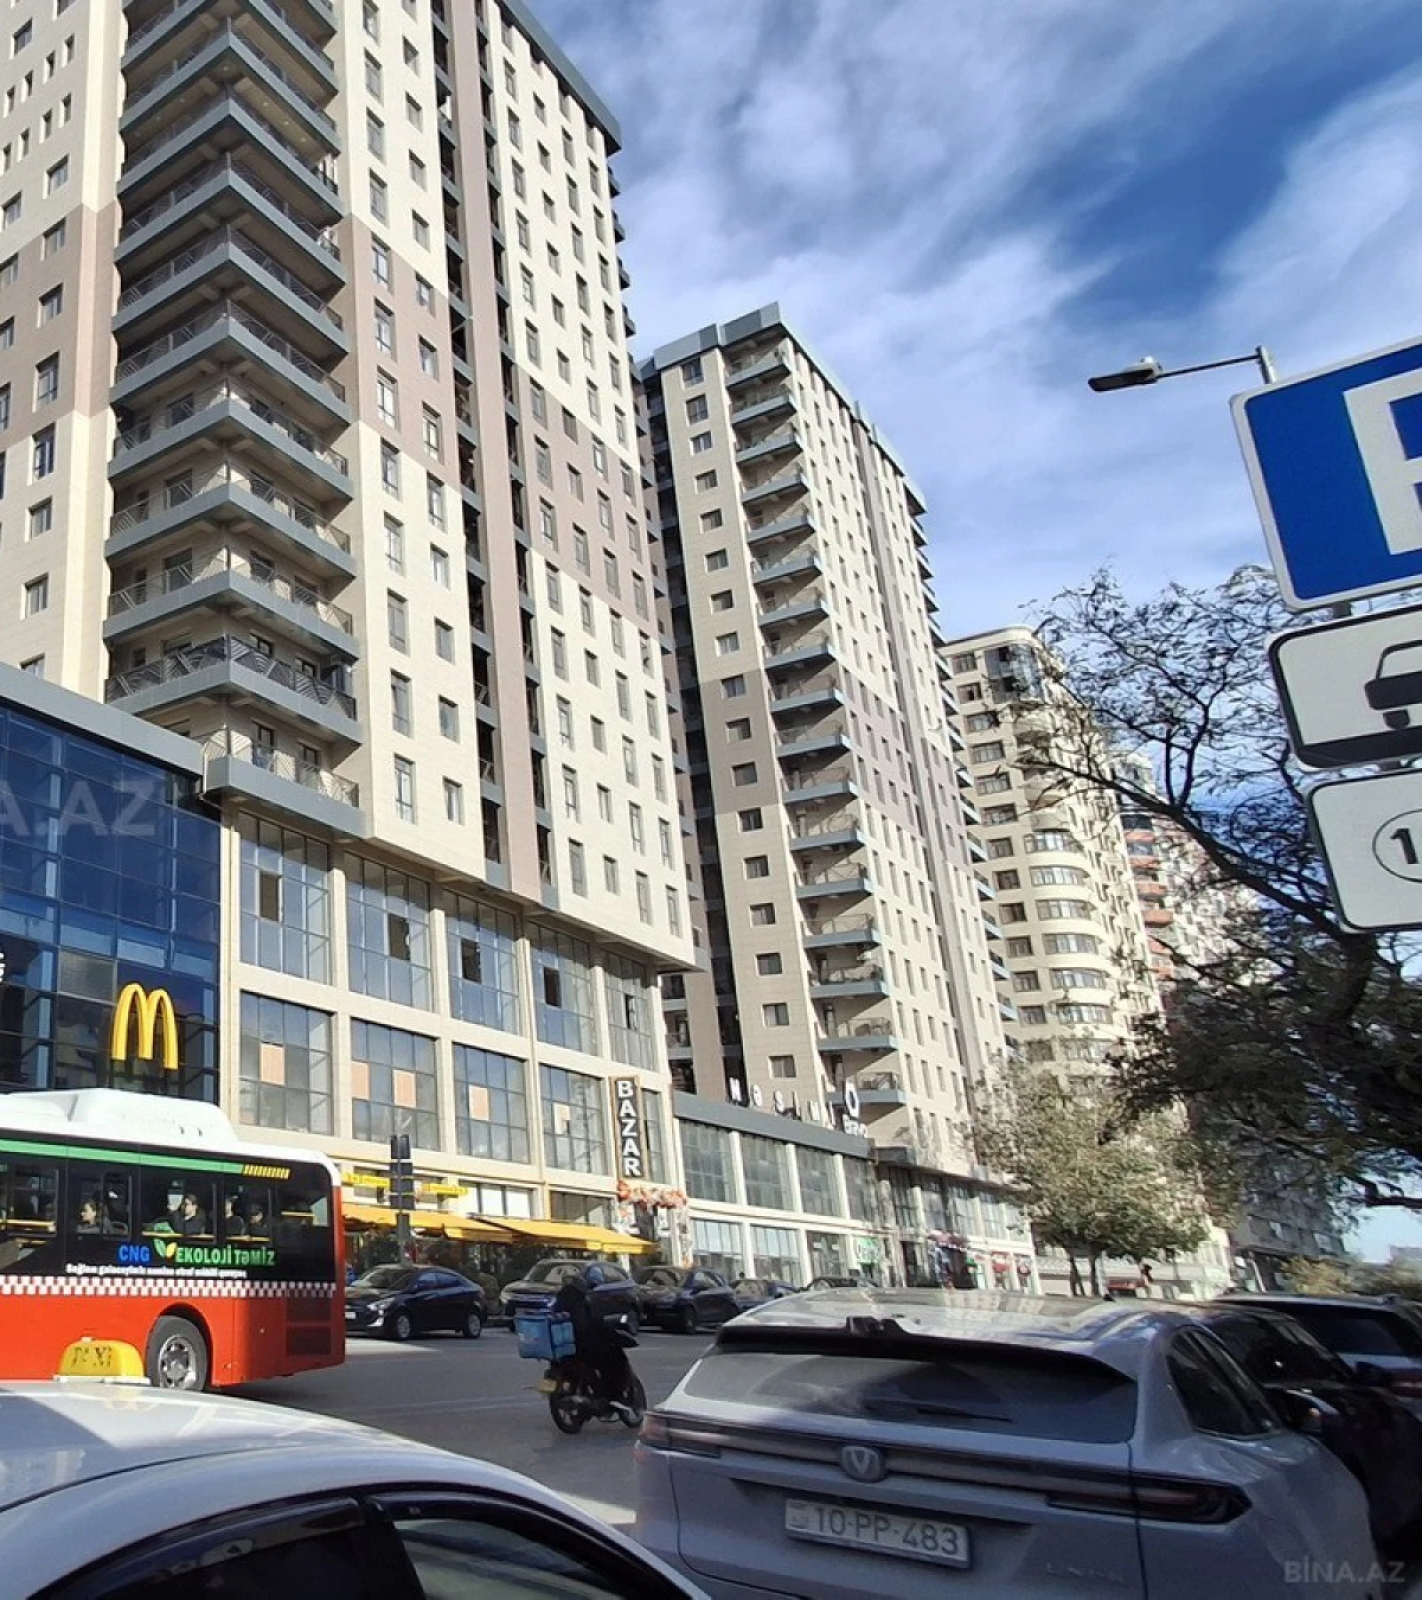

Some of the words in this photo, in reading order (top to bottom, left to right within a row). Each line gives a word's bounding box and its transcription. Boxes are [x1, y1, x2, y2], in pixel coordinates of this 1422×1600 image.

[616, 1080, 642, 1177] BAZAR
[117, 1244, 150, 1263] CNG
[175, 1243, 232, 1265] EKOLOJİ
[816, 1507, 959, 1555] 10-PP-483
